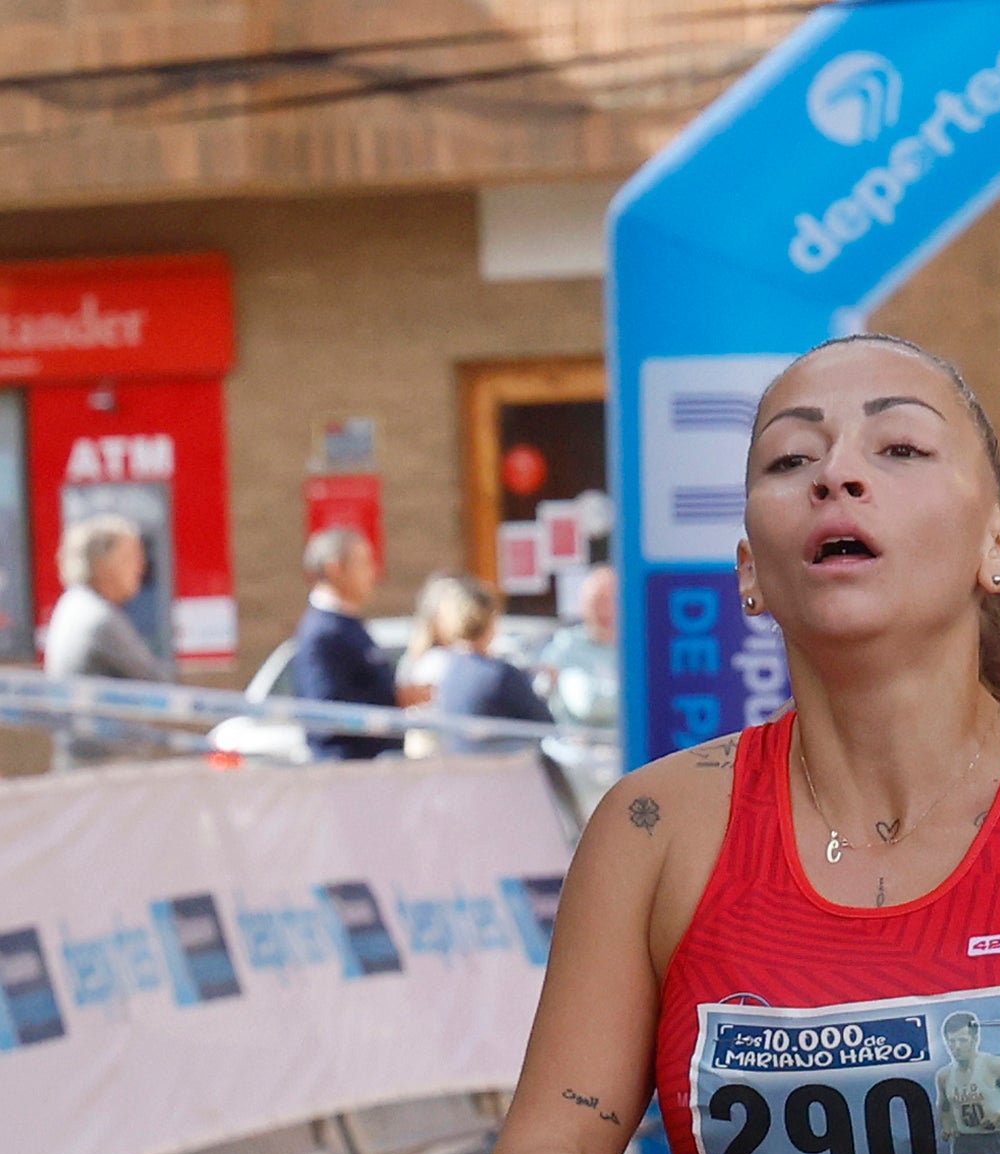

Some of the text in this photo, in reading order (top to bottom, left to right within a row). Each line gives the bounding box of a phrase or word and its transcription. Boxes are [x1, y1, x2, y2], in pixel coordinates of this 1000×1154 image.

[65, 433, 175, 482] ATM
[669, 585, 722, 677] DE
[725, 1042, 912, 1069] MARIANO HARO
[763, 1025, 864, 1052] 10.000
[863, 1034, 887, 1048] de
